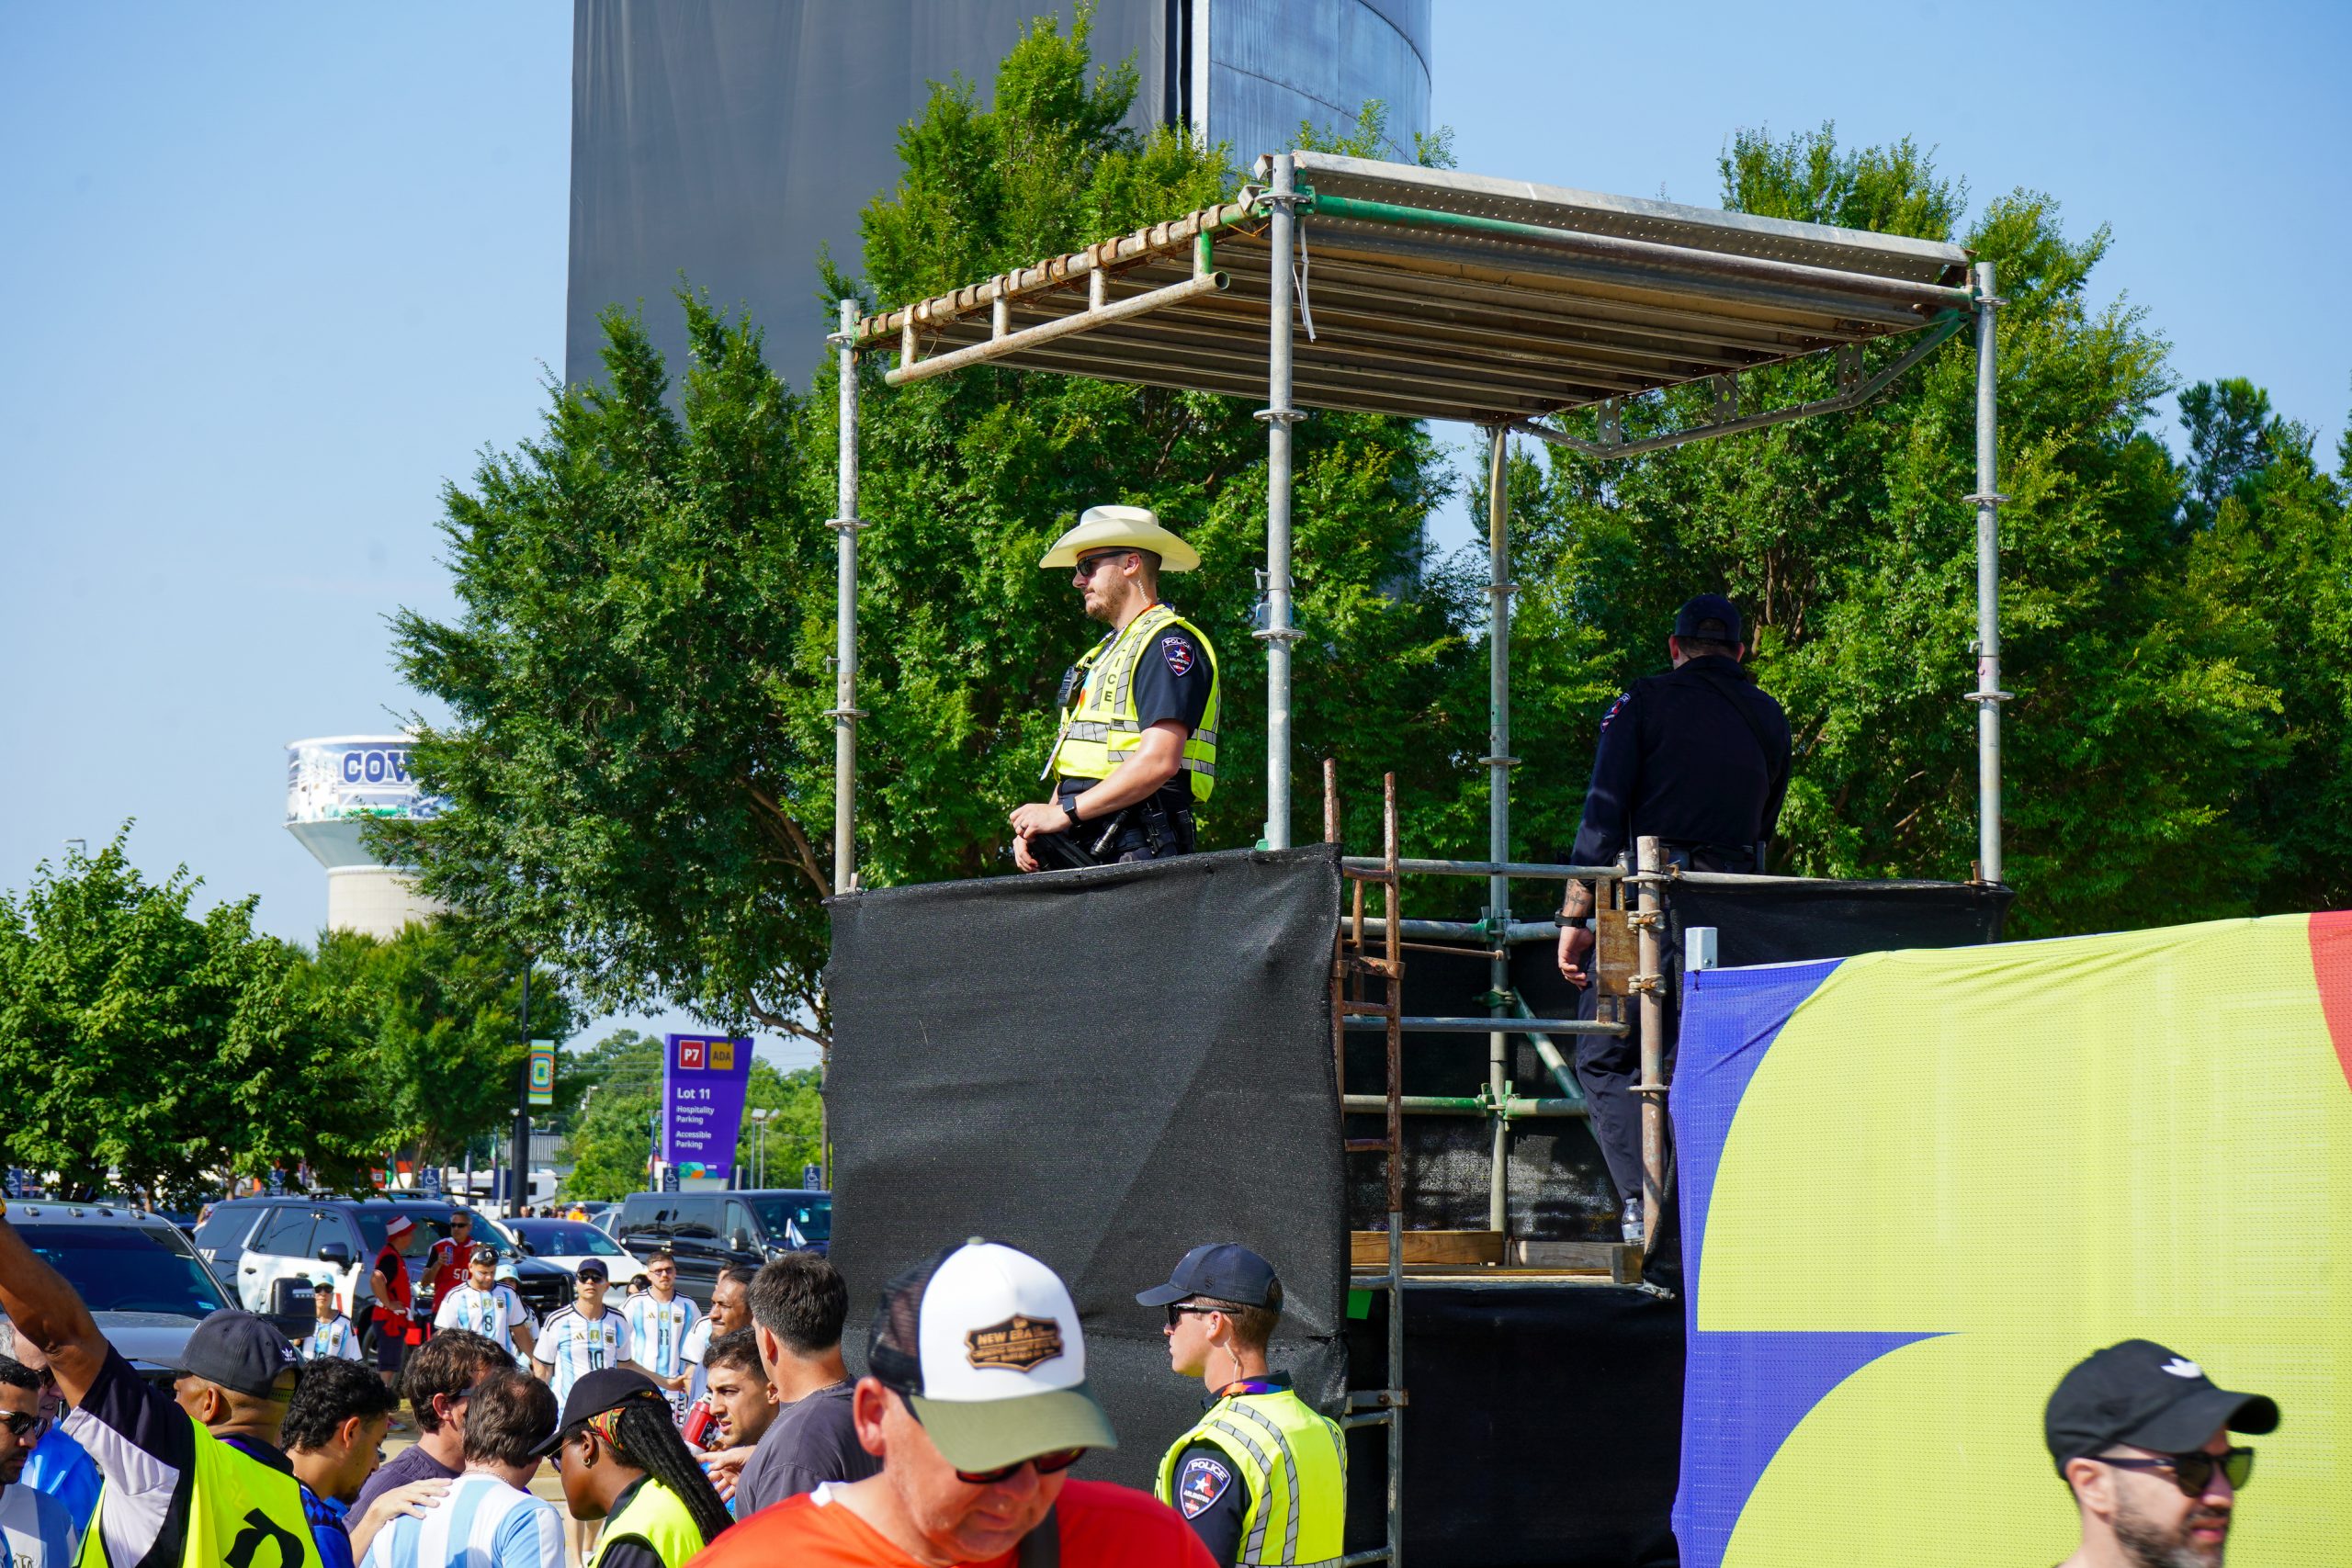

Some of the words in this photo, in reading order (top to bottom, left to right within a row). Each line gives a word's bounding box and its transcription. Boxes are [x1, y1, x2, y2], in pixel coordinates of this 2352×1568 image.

[684, 1048, 700, 1062] P7
[712, 1050, 731, 1062] ADA
[676, 1088, 695, 1100] Lot
[699, 1088, 711, 1100] 11
[676, 1105, 715, 1115] Hospitality
[676, 1116, 704, 1125] Parking
[675, 1131, 711, 1139] Accessible
[675, 1140, 703, 1150] Parking
[453, 1268, 469, 1281] 50
[484, 1314, 493, 1332] 8
[660, 1328, 670, 1346] 11
[978, 1332, 1007, 1346] NEW
[1010, 1328, 1033, 1341] ERA
[588, 1348, 605, 1371] 10
[1191, 1461, 1227, 1482] POLICE
